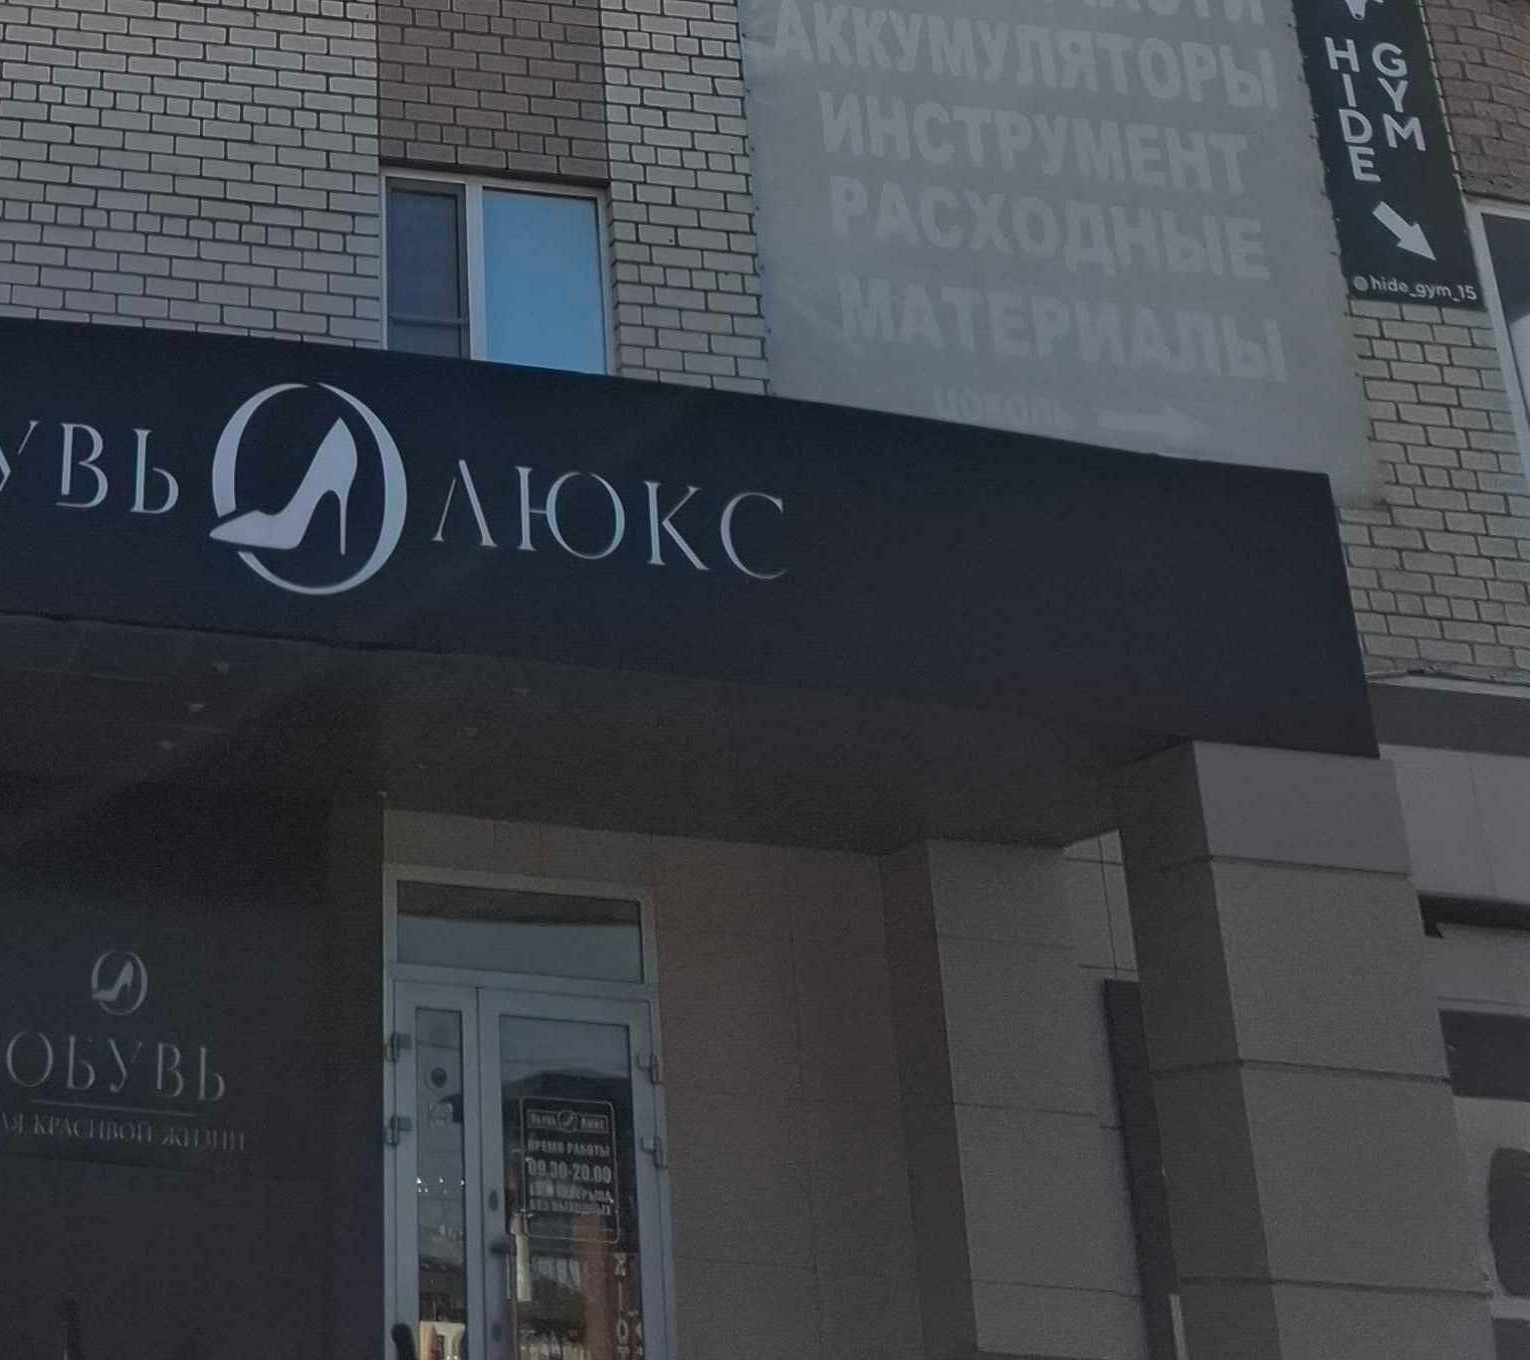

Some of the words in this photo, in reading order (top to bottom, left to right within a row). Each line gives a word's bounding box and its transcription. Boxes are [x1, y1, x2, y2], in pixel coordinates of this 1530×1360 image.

[771, 0, 1279, 111] АККУМУЛЯТОРЫ
[1372, 42, 1426, 152] GYM
[819, 91, 1248, 197] ИНСТРУМЕНТ
[1324, 36, 1381, 183] HIDE
[829, 176, 1266, 280] РАСХОДНЫЕ
[838, 278, 1284, 384] МАТЕРИАЛЫ
[1369, 274, 1478, 302] hide_gym_15
[431, 458, 788, 580] ЛЮКС
[6, 1031, 226, 1102] ОБУВЬ
